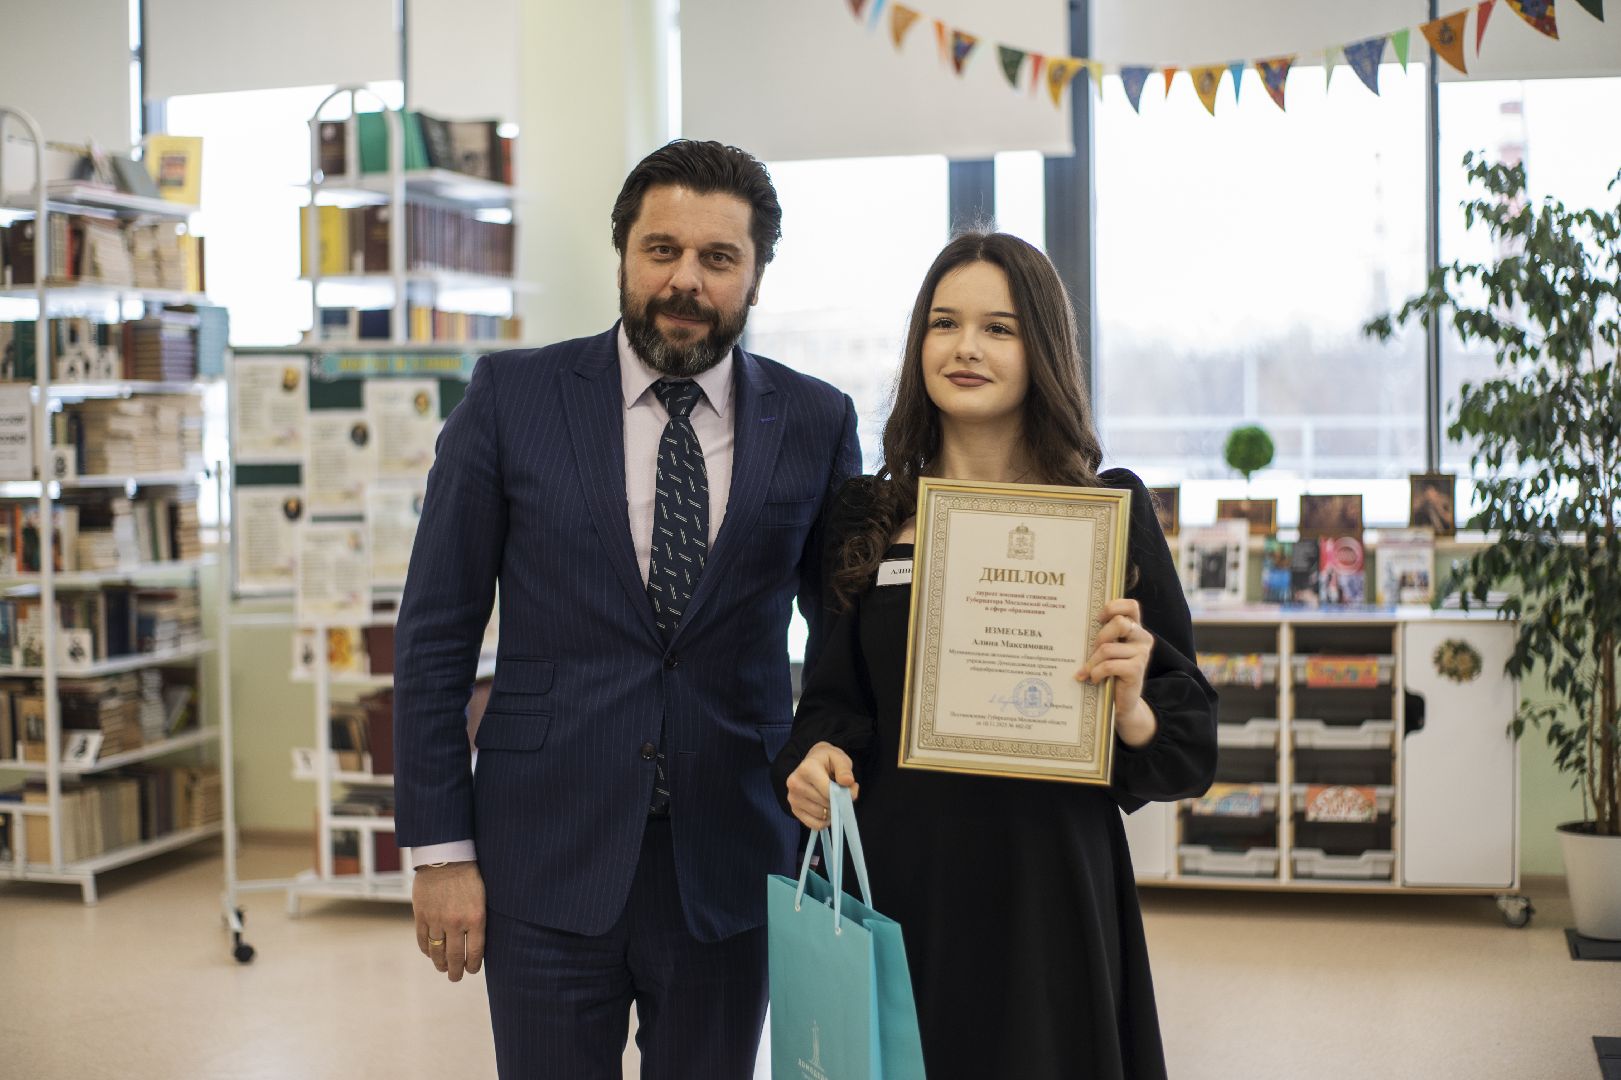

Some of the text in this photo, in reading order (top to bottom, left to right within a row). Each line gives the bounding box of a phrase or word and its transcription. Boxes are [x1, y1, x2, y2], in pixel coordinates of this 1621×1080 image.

[979, 567, 1066, 587] ДИПЛОМ
[965, 596, 1003, 606] Губернатора
[990, 605, 1007, 613] сфере
[1008, 606, 1046, 615] образования
[984, 626, 1043, 638] ИЗМЕСЬЕВА
[972, 639, 1054, 651] Алина Максимовна
